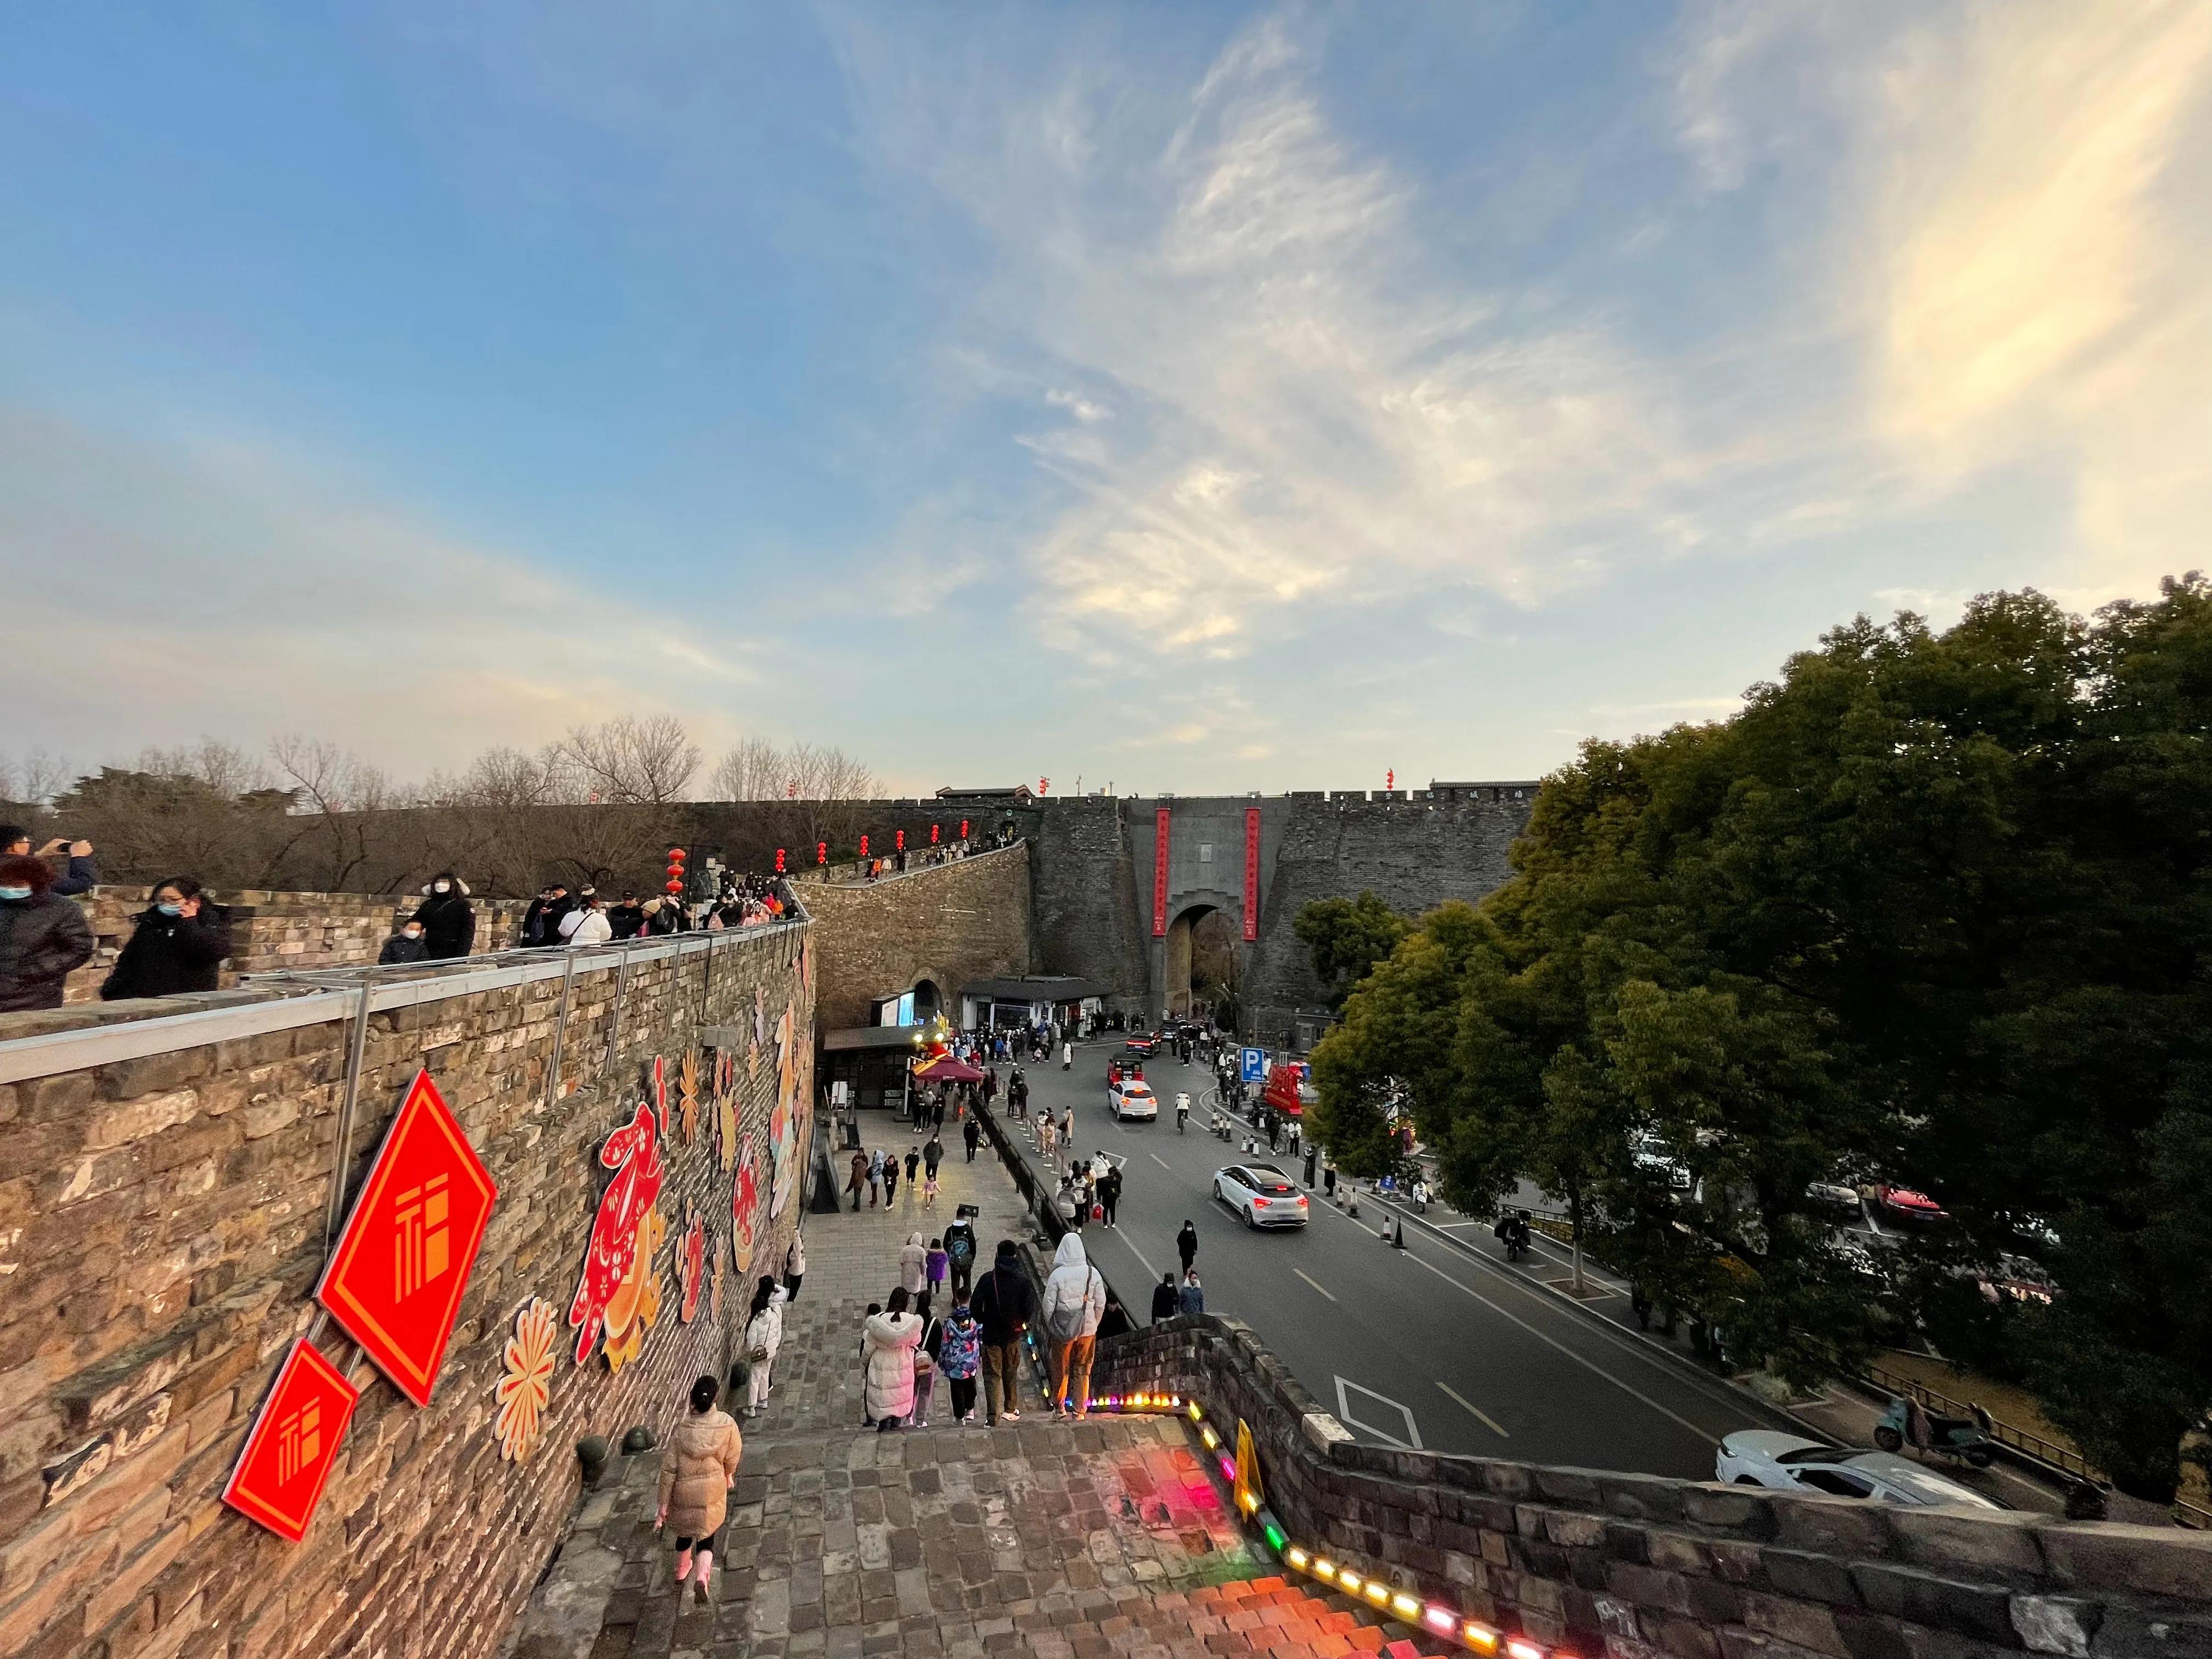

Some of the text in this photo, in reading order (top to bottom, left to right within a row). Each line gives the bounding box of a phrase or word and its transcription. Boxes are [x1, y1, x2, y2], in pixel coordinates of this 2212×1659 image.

[1246, 1051, 1259, 1071] P
[395, 1172, 449, 1304] 福
[279, 1396, 320, 1488] 福
